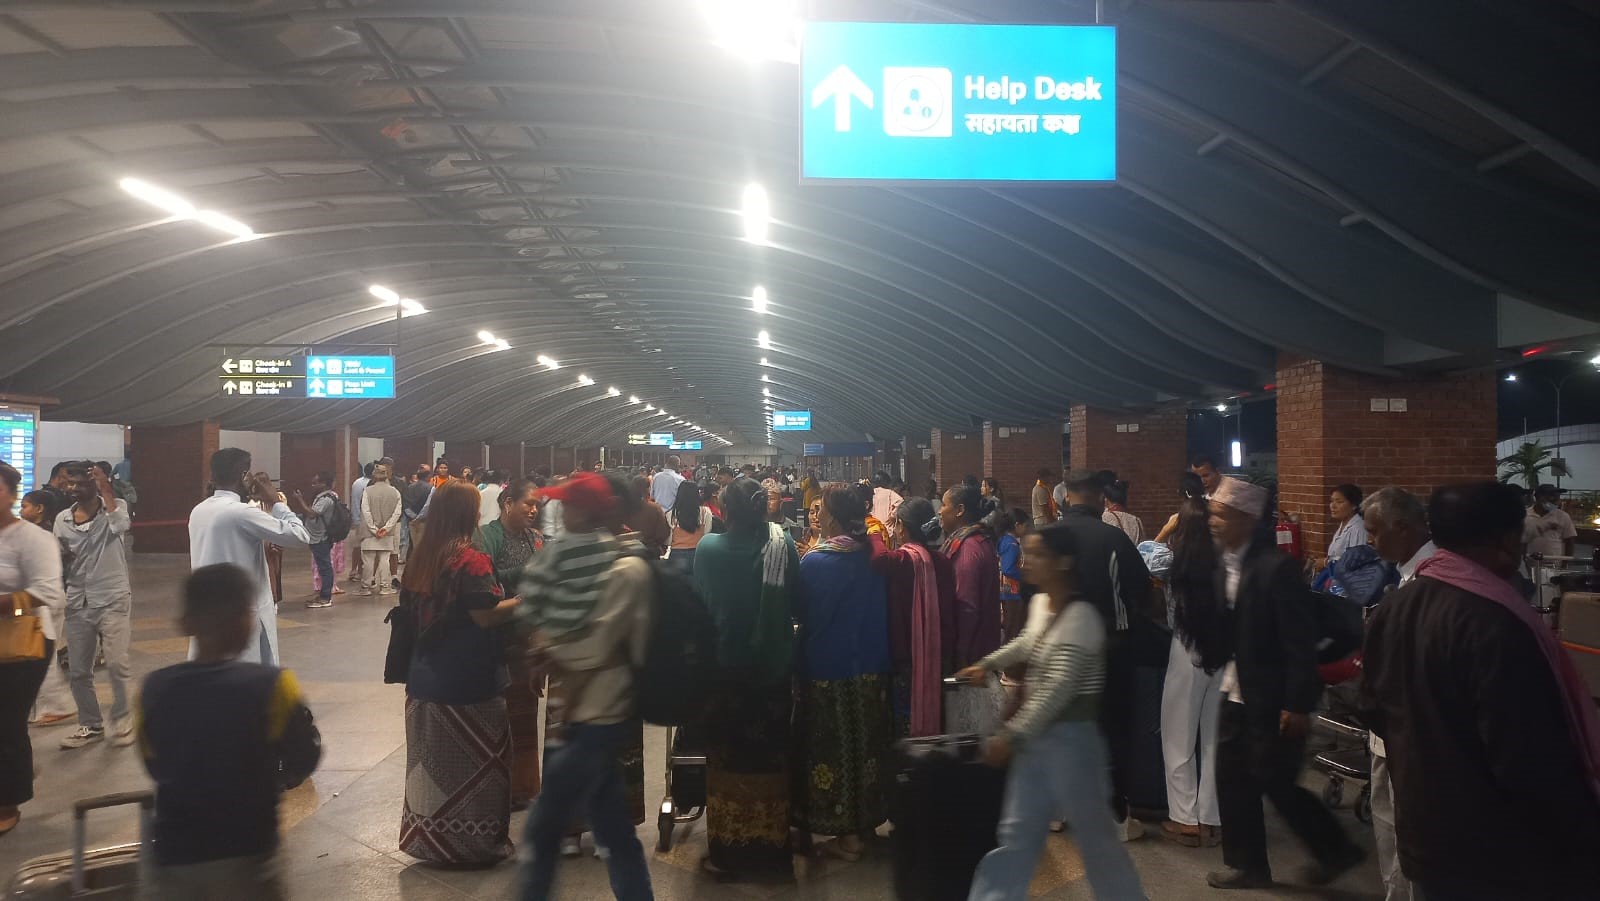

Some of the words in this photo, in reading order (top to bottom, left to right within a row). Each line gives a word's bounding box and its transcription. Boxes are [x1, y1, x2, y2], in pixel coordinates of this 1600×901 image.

[964, 75, 1027, 105] Help
[1034, 75, 1103, 101] Desk
[964, 113, 1039, 135] सहायता
[285, 359, 292, 367] A
[286, 380, 293, 388] B
